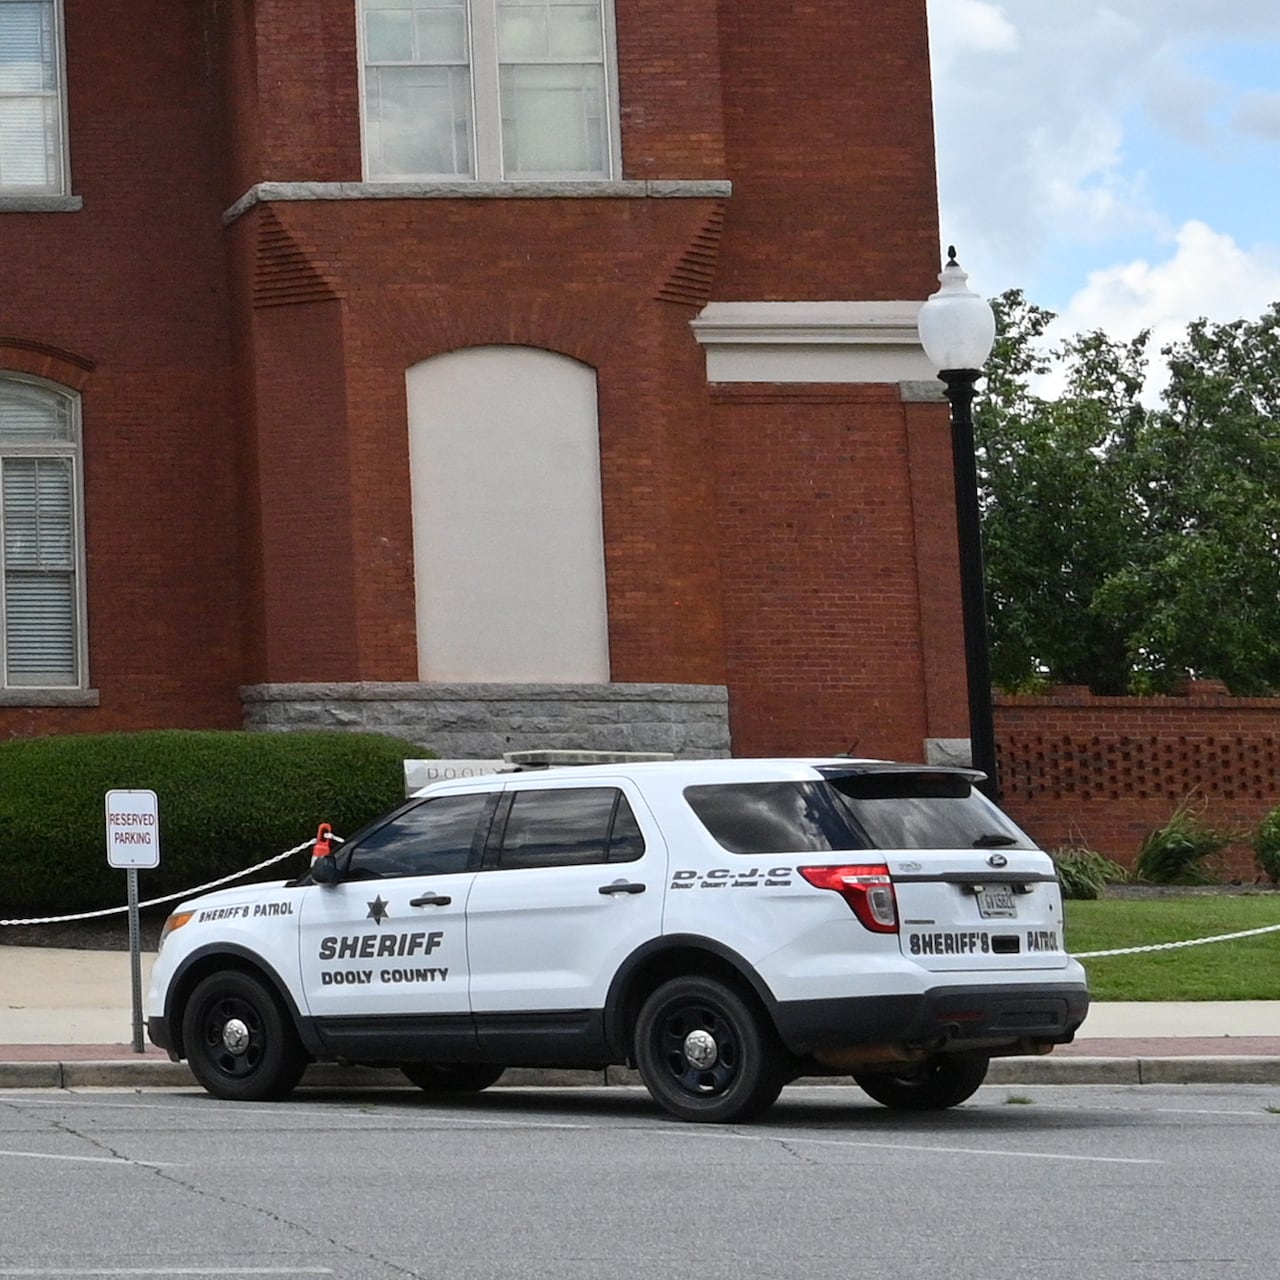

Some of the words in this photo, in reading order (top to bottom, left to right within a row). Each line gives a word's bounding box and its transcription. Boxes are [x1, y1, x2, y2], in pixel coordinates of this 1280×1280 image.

[109, 813, 155, 826] RESERVED
[114, 832, 151, 845] PARKING
[672, 867, 793, 881] D.C.J.C
[198, 905, 250, 924] SHERIFF'S
[253, 901, 294, 917] PATROL
[318, 931, 444, 960] SHERIFF
[909, 932, 990, 956] SHERIFF'S
[1027, 930, 1059, 953] PATROL
[321, 969, 373, 986] DOOLY
[379, 967, 449, 983] COUNTY
